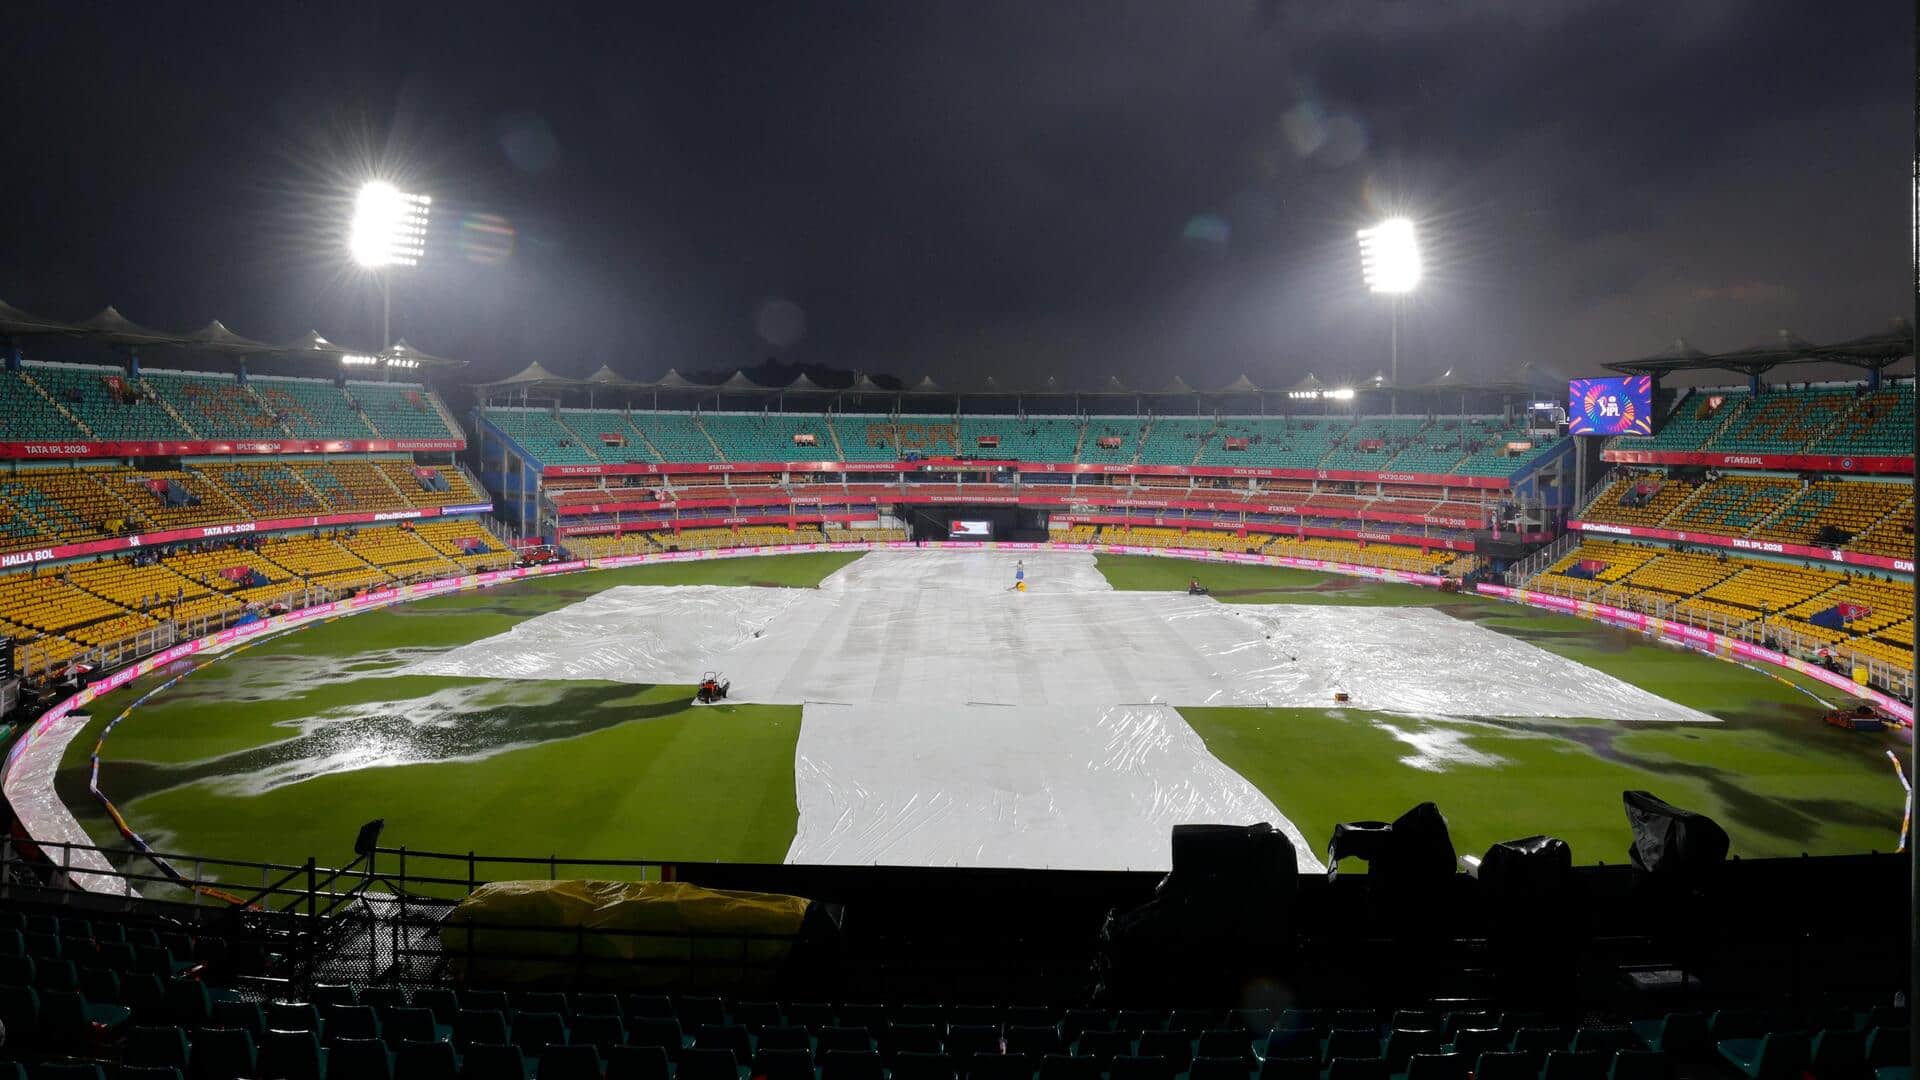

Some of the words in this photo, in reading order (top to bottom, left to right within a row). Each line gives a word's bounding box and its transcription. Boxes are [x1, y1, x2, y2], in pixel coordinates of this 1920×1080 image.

[1606, 406, 1620, 417] IPL
[25, 445, 48, 454] TATA
[50, 445, 63, 454] IPL
[64, 445, 87, 454] 2026
[1724, 456, 1763, 465] #TATAIPL
[1378, 473, 1415, 481] IPLT20.COM
[1268, 505, 1296, 513] #TATAIPL
[203, 527, 222, 536] TATA
[223, 525, 235, 534] IPL
[236, 523, 256, 532] 2026
[1357, 532, 1390, 541] GUWAHATI
[1732, 539, 1750, 549] TATA
[1751, 541, 1763, 550] IPL
[1763, 543, 1783, 552] 2026
[2, 552, 34, 567] HALLA
[34, 549, 55, 561] BOL
[1615, 608, 1640, 621] MEERUT
